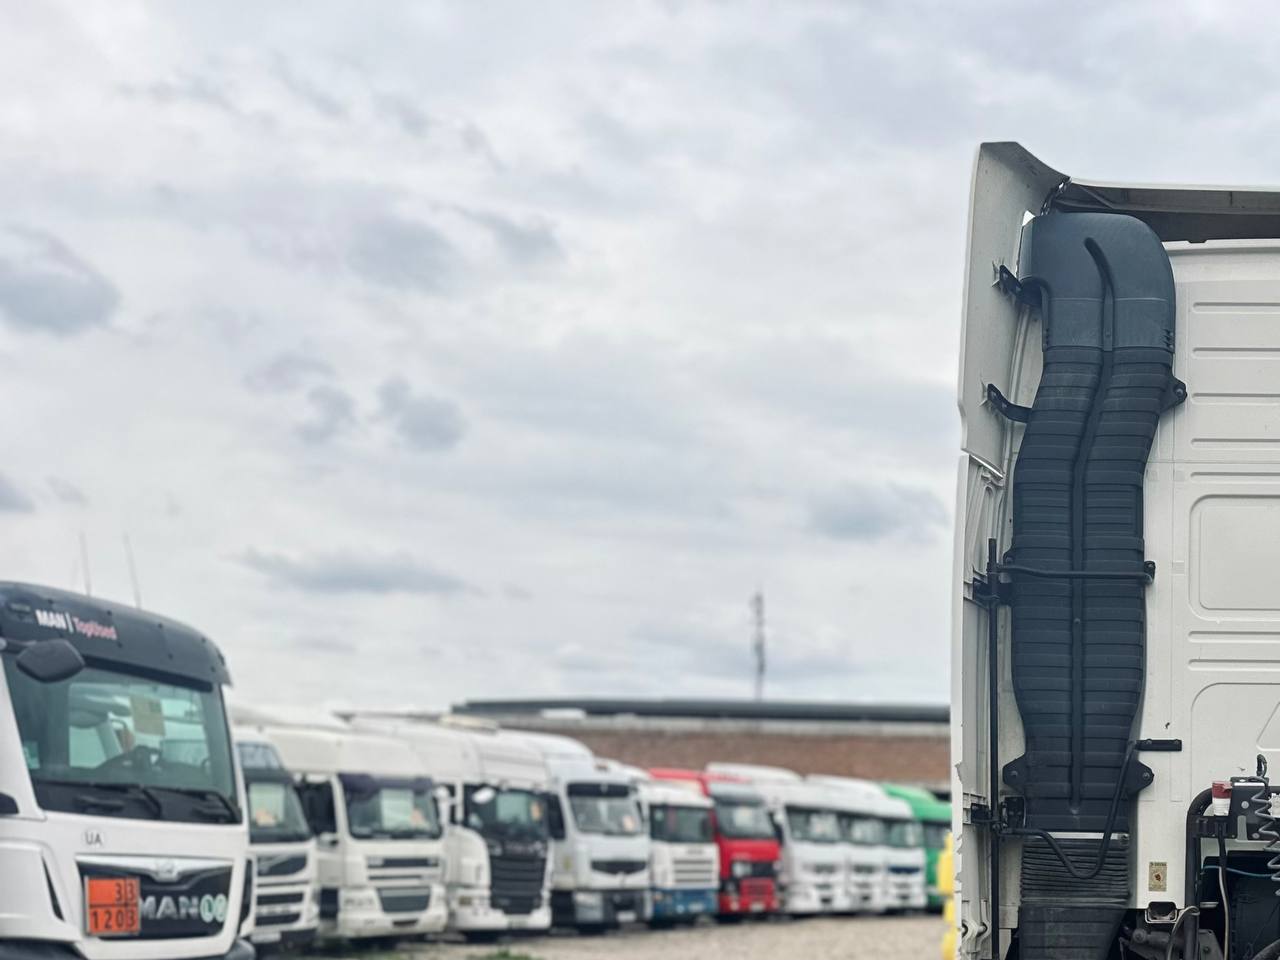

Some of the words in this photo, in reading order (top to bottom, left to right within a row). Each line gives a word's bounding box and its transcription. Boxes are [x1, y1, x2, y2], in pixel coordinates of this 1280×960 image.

[84, 831, 103, 846] UA
[114, 882, 137, 898] 33
[91, 910, 136, 929] 1203
